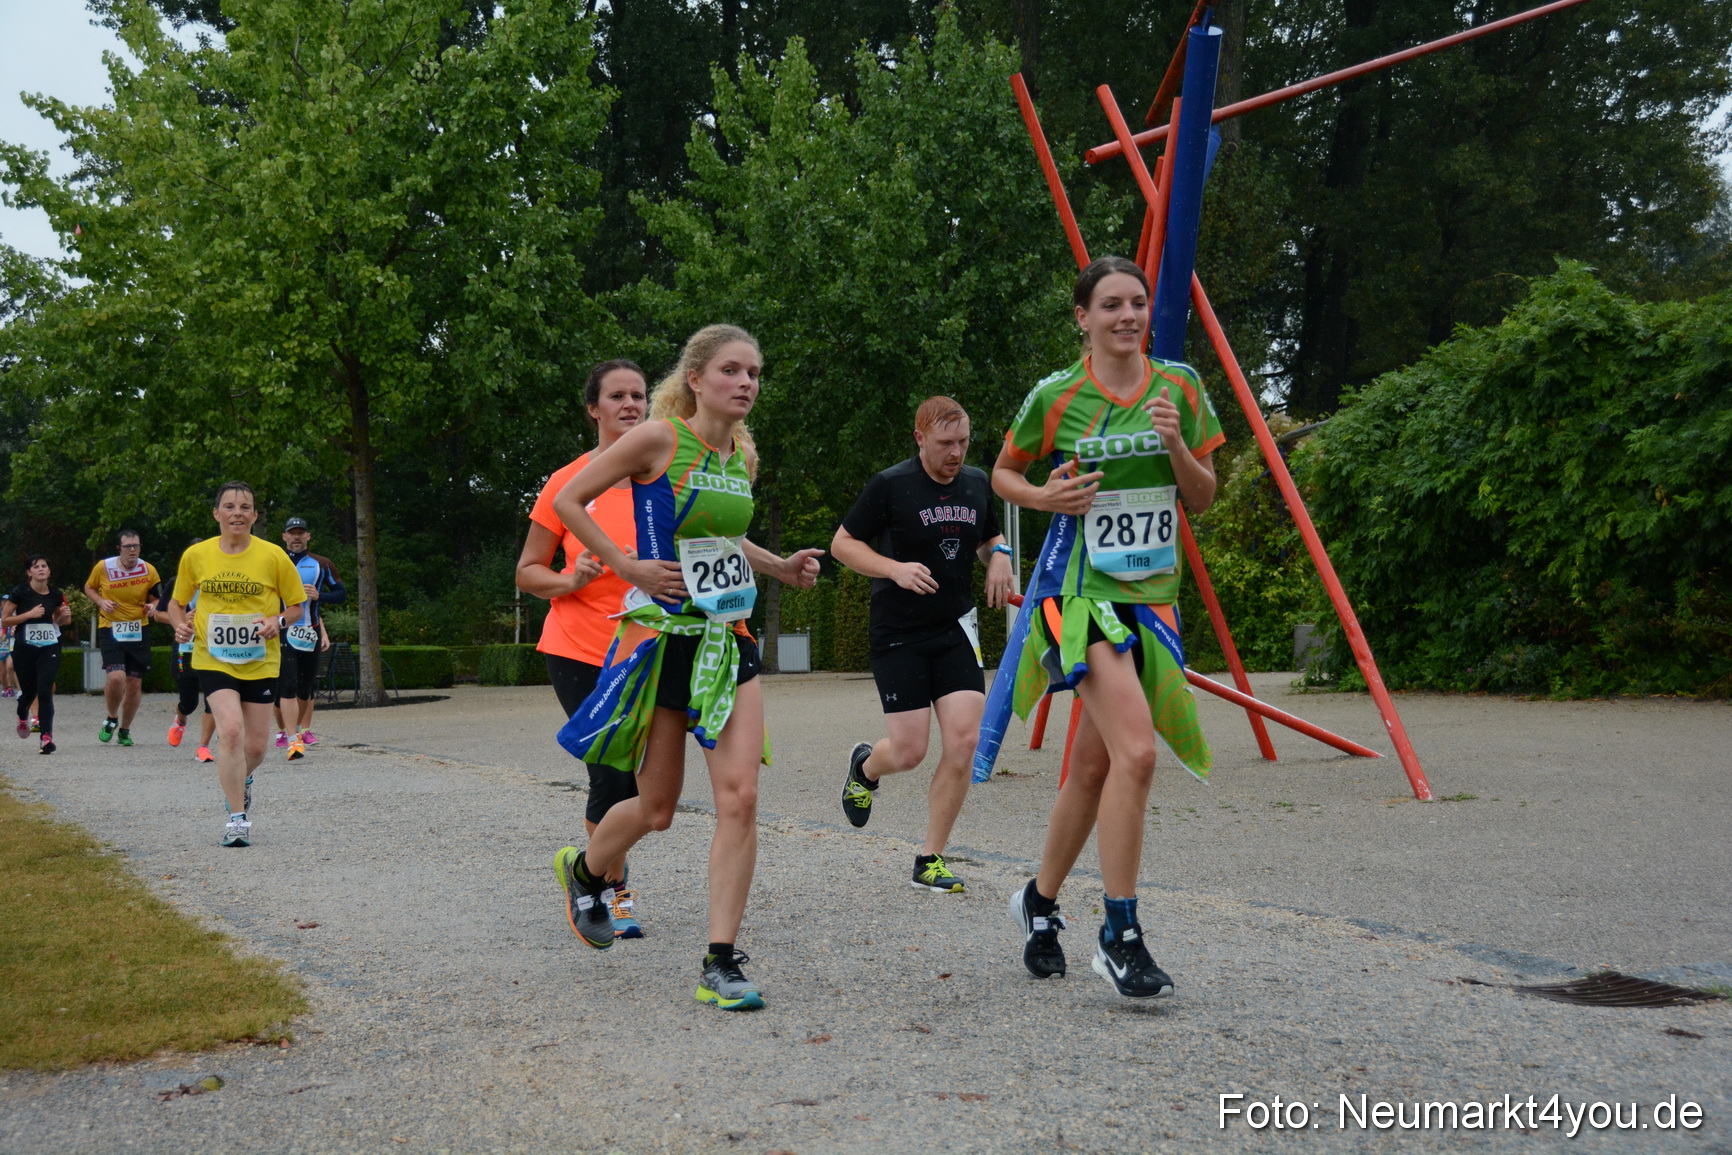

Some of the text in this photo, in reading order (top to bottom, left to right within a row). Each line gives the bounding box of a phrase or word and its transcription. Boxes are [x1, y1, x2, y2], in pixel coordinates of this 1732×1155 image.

[689, 471, 753, 498] BOCK
[919, 506, 976, 526] FLORIDA
[1096, 510, 1172, 548] 2878
[1125, 554, 1150, 568] Tina
[110, 578, 150, 590] MAX BÖGL
[206, 581, 257, 594] FRANCESCO
[116, 622, 139, 632] 2769
[30, 630, 54, 640] 2305
[214, 626, 261, 645] 3094
